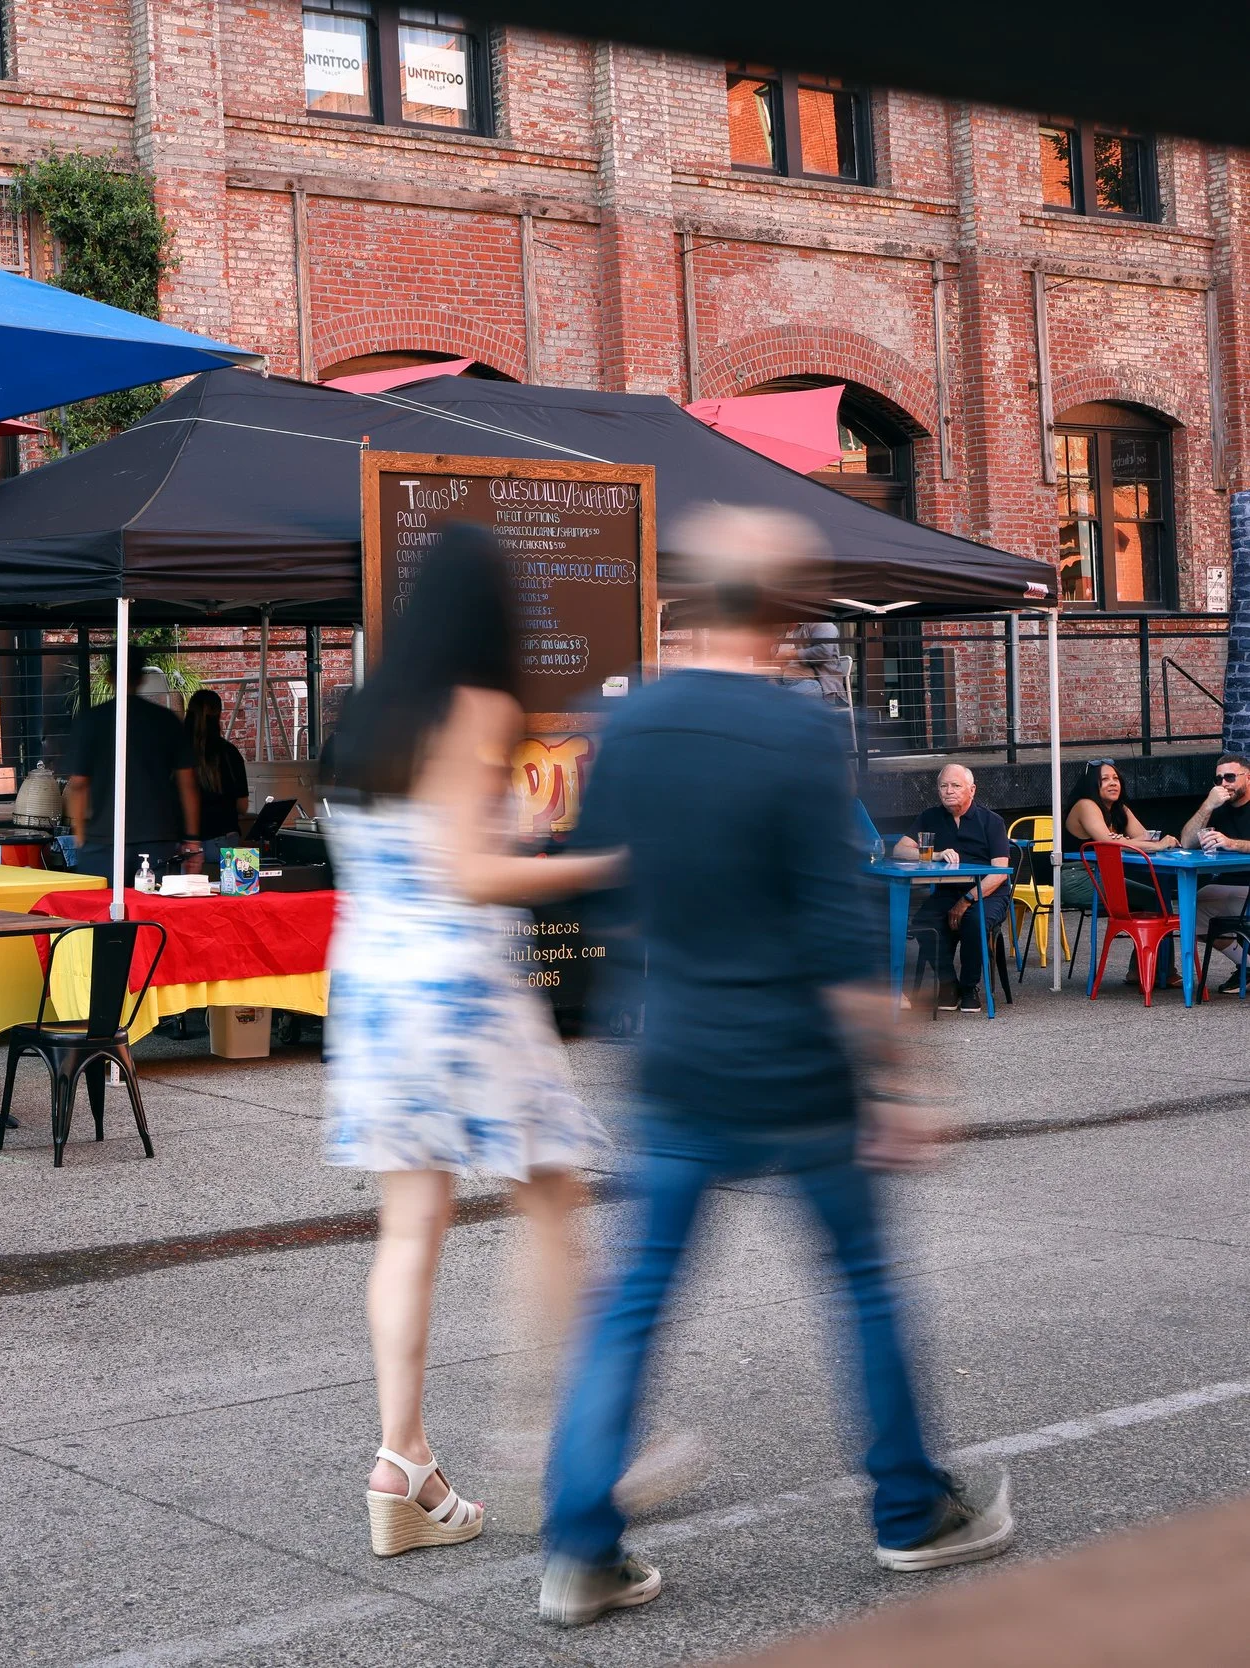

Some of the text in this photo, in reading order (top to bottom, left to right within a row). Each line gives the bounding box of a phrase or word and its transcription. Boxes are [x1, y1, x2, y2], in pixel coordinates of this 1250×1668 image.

[407, 66, 464, 85] UNTATTOO
[396, 511, 427, 528] POLLO
[524, 511, 561, 523] OPTIONS
[551, 563, 567, 576] ANY
[569, 564, 593, 577] FOOD
